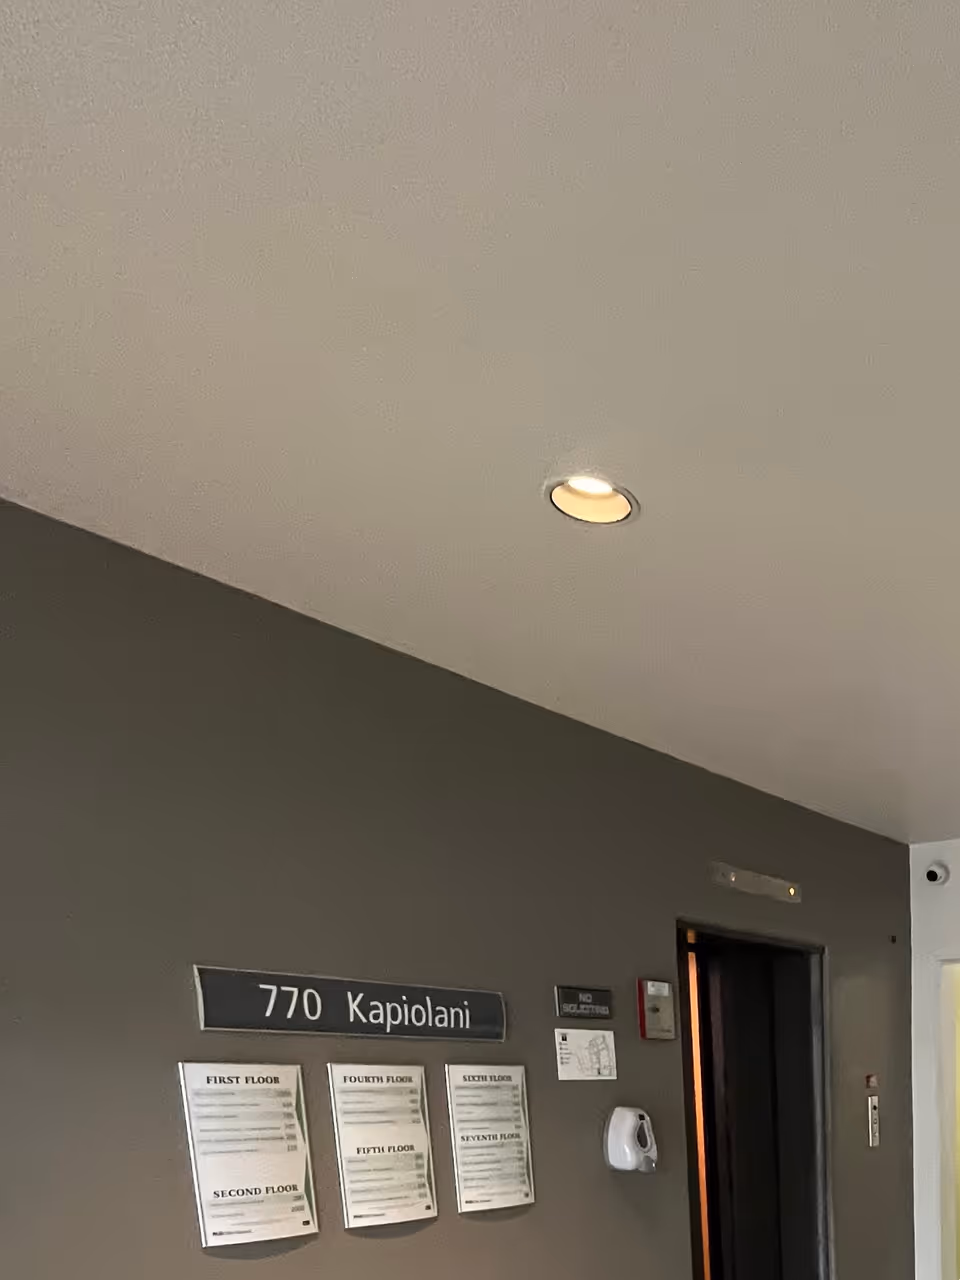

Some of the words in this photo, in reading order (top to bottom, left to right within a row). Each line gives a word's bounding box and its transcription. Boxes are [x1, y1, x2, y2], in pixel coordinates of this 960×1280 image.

[579, 993, 593, 1003] NO
[258, 984, 322, 1021] 770
[347, 991, 470, 1033] Kapiolani
[206, 1076, 240, 1084] FIRST
[245, 1076, 280, 1084] FLOOR
[461, 1134, 498, 1142] SEVENTH
[499, 1133, 521, 1141] FLOOR
[356, 1146, 385, 1155] FIFTH
[388, 1145, 415, 1153] FLOOR
[213, 1187, 261, 1198] SECOND
[265, 1184, 299, 1194] FLOOR
